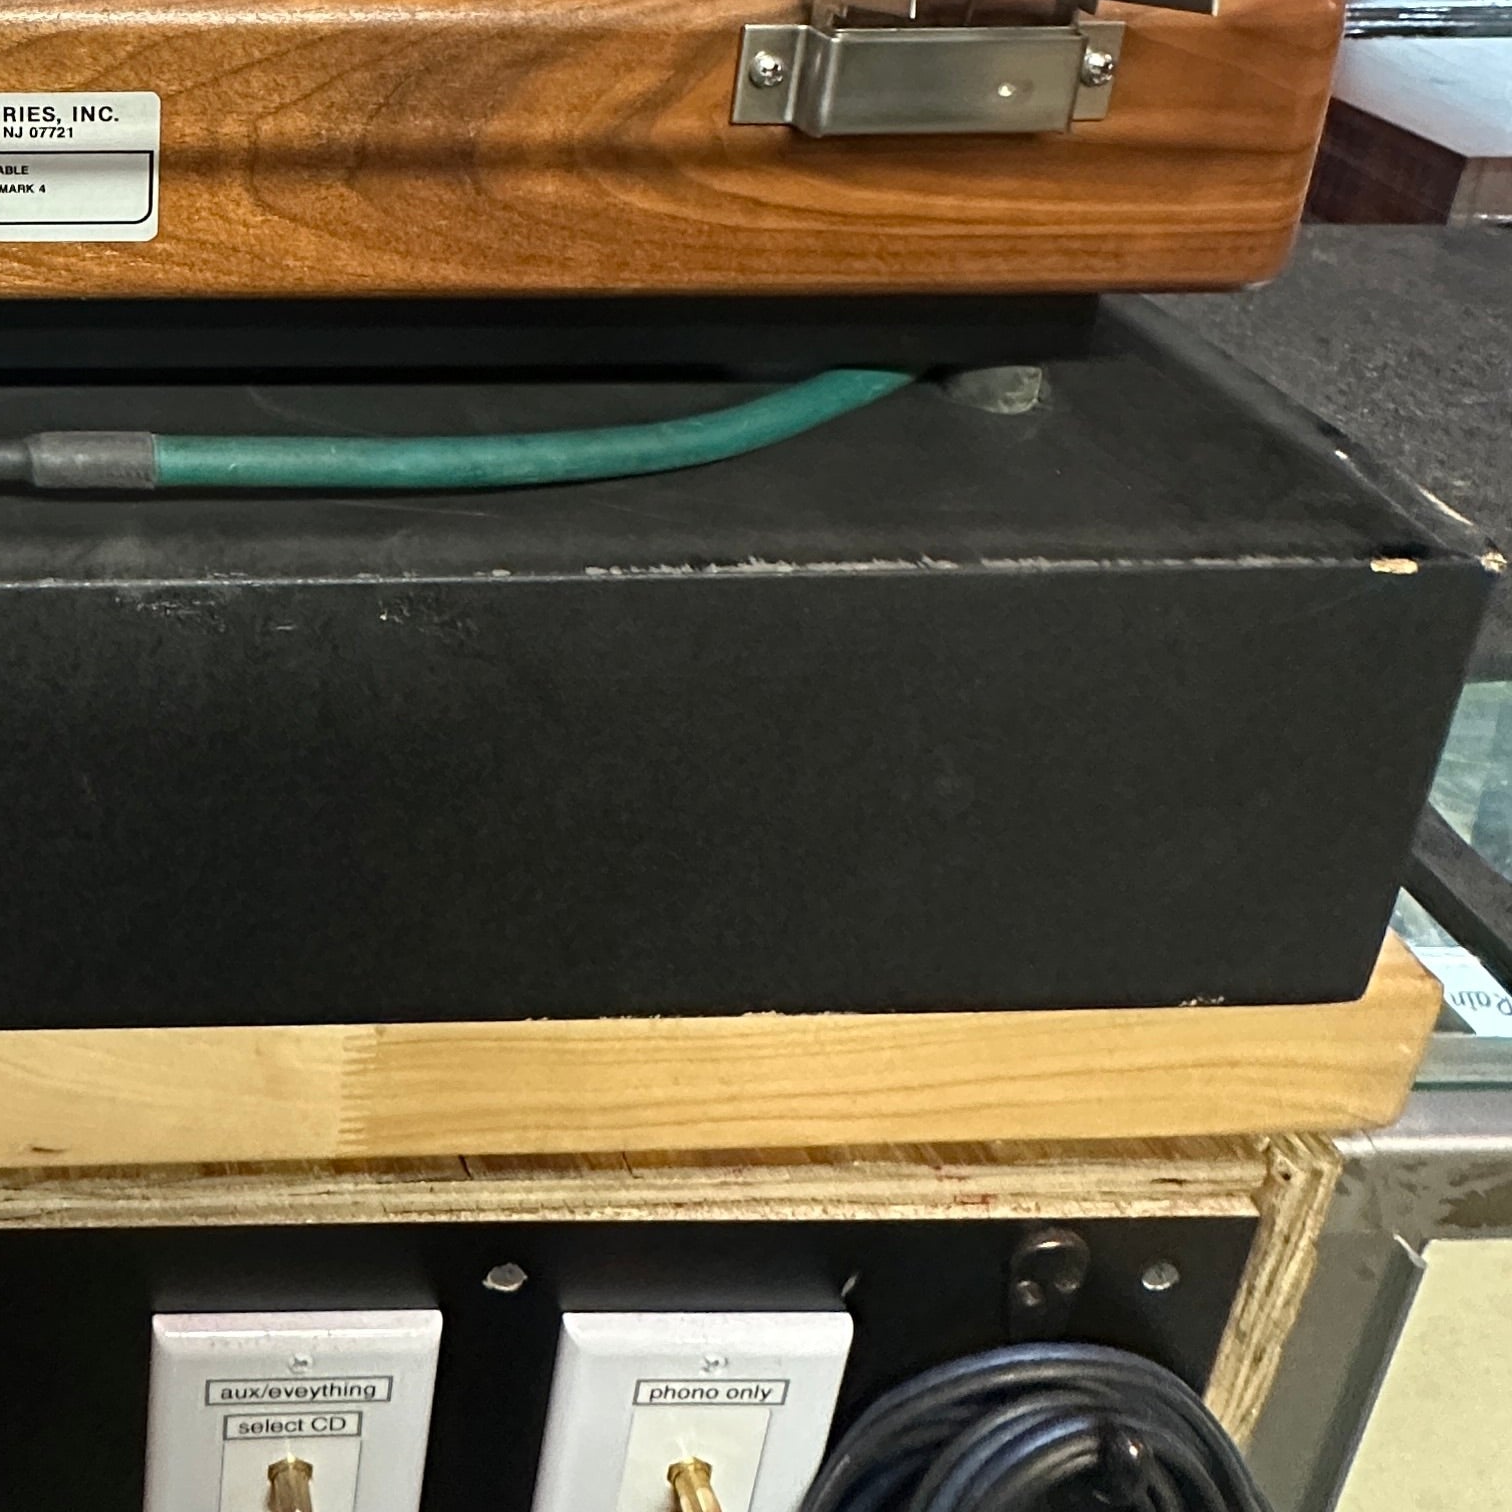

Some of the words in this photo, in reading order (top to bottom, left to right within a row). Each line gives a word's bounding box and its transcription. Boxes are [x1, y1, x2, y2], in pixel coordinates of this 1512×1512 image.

[72, 105, 120, 123] INC.
[3, 126, 24, 139] NJ
[29, 126, 74, 139] 07721
[220, 1382, 377, 1402] aux/eveything
[648, 1384, 719, 1402] phono
[726, 1384, 774, 1402] only
[238, 1417, 305, 1435] select
[310, 1415, 348, 1433] CD
